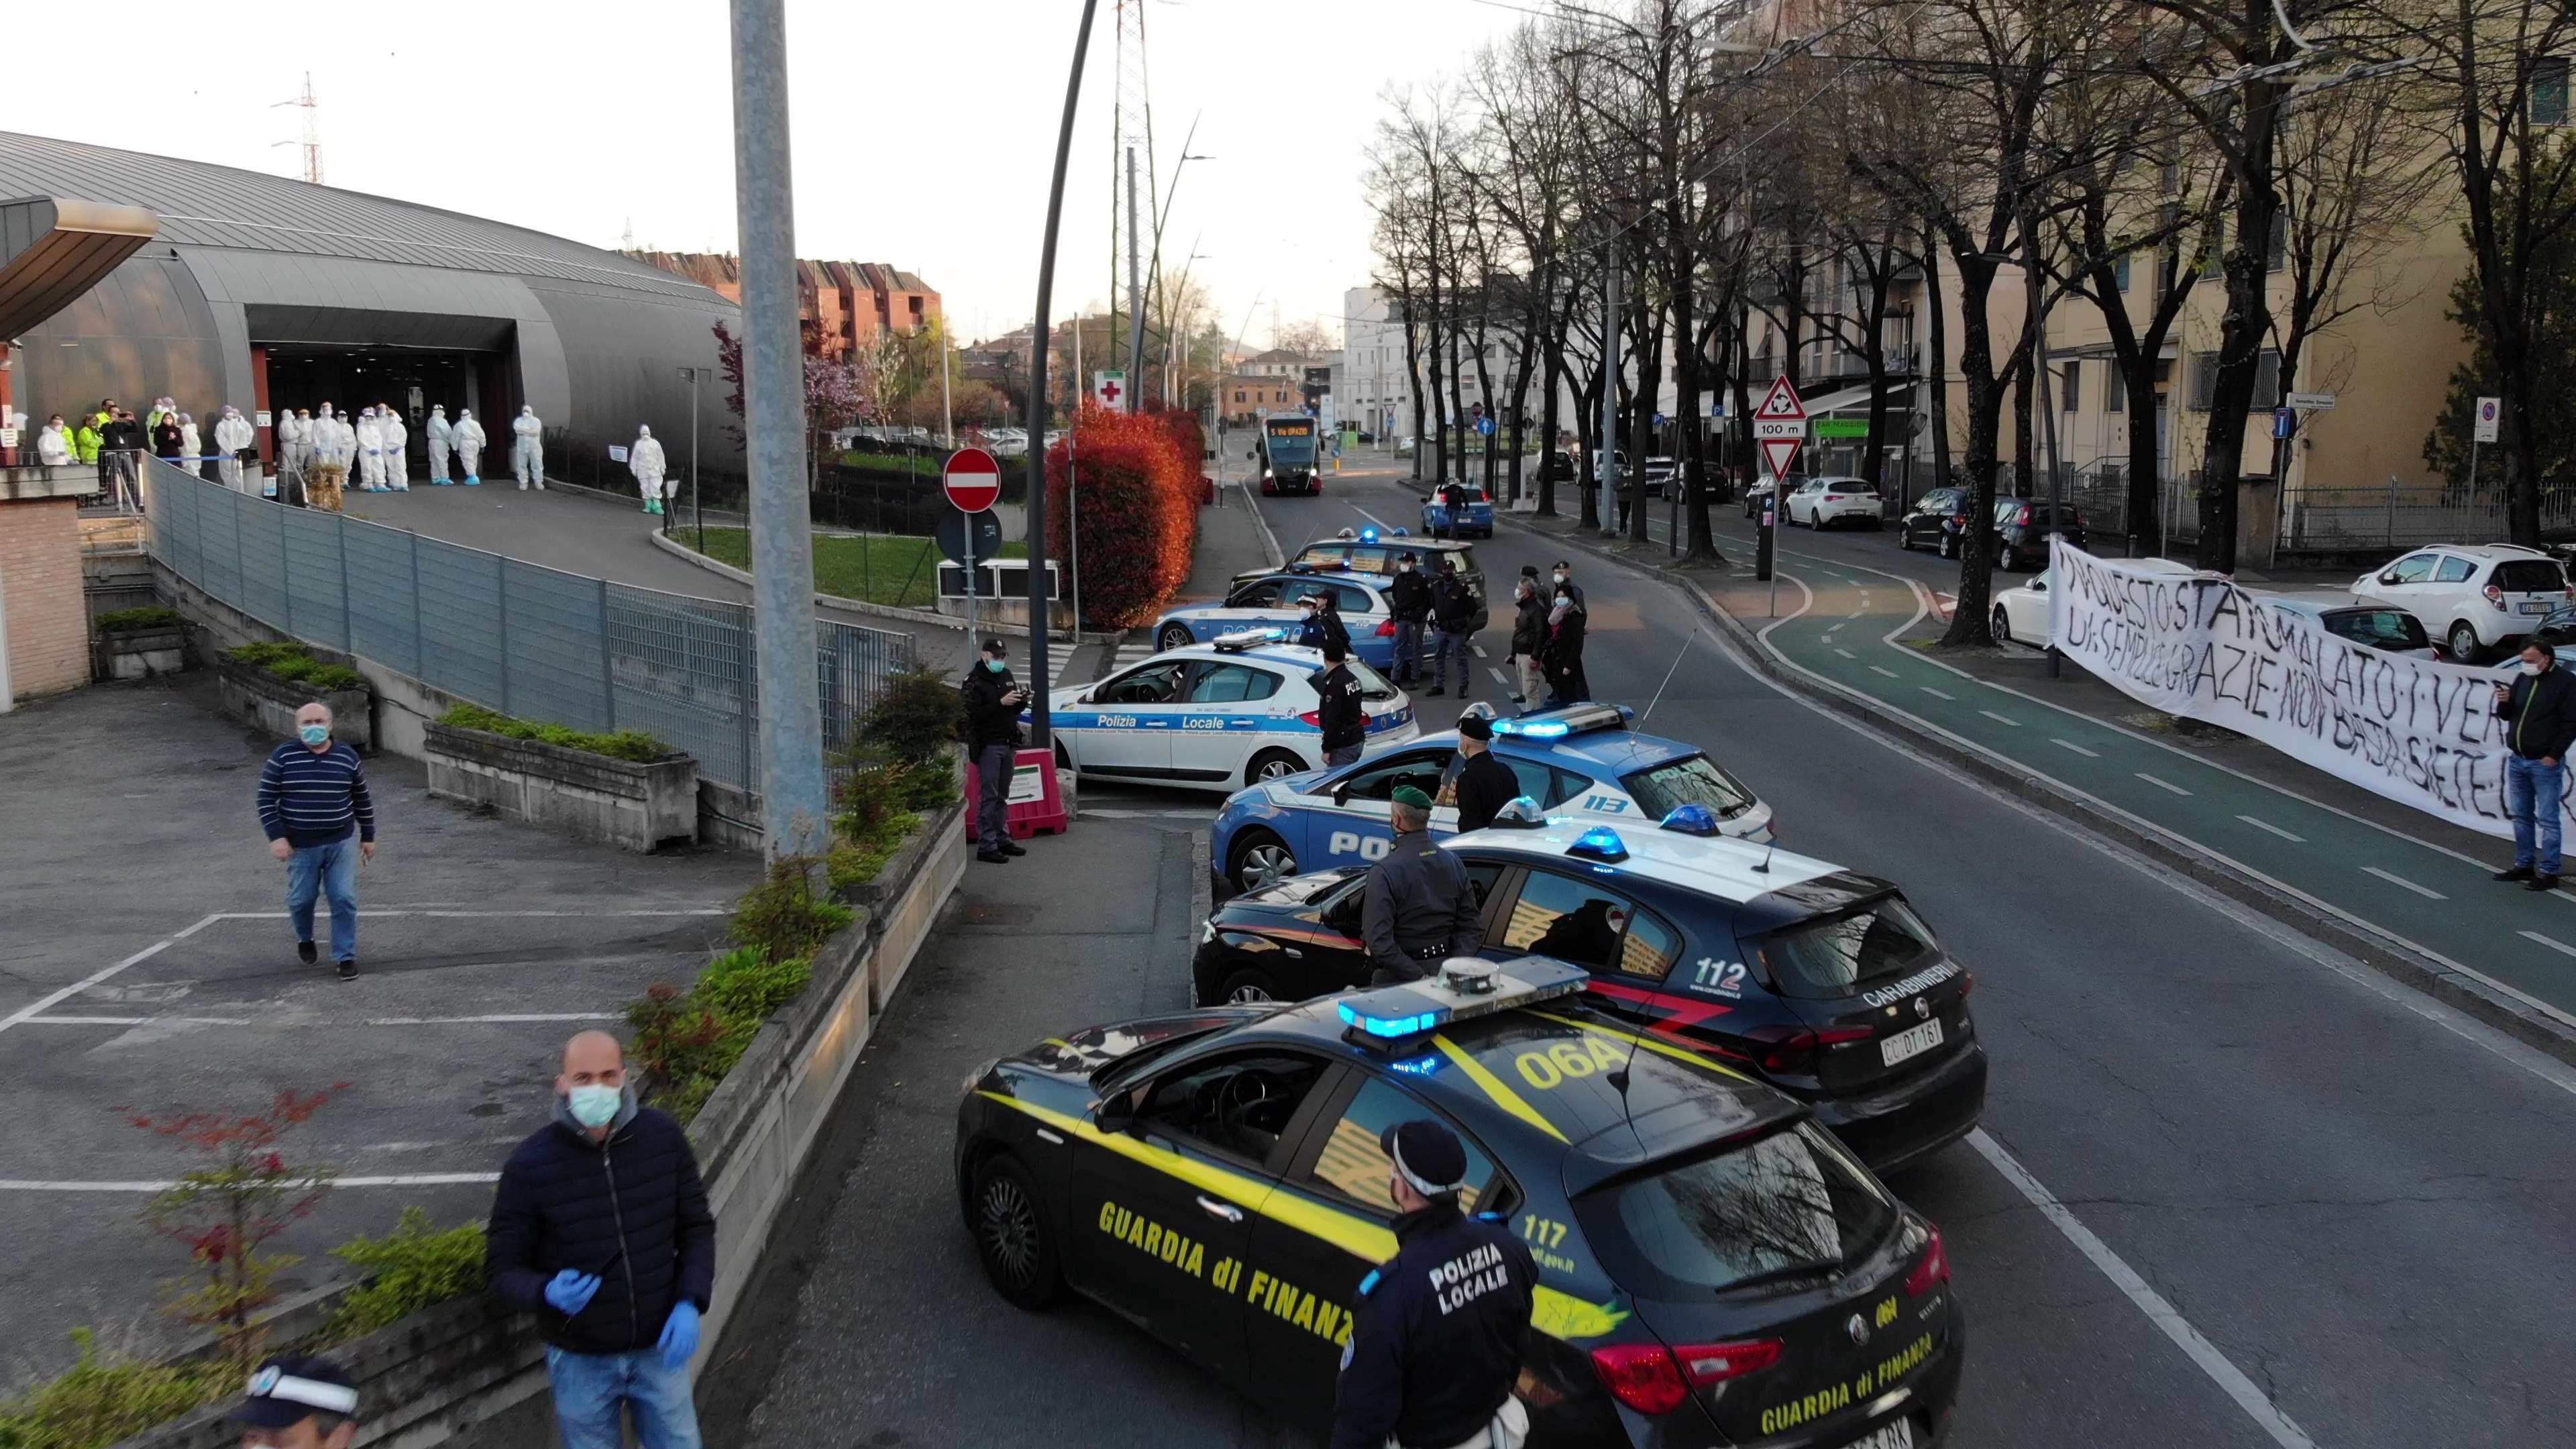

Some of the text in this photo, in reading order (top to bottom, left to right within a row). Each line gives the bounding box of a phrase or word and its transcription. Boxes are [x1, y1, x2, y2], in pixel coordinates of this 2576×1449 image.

[1762, 425, 1782, 434] 100
[1097, 714, 1224, 729] Polizia Locale
[2432, 672, 2514, 746] VER
[1583, 795, 1629, 814] 113
[1695, 957, 1746, 991] 112
[1862, 963, 1954, 1007] CARABINIERI
[1921, 1022, 1939, 1047] 161
[1515, 1036, 1635, 1089] 06A
[1524, 1214, 1568, 1250] 117
[1099, 1201, 1354, 1348] GUARDIA di FINANZ
[1428, 1242, 1503, 1292] POLIZIA
[1438, 1264, 1509, 1316] LOCALE
[1762, 1331, 1933, 1435] GUARDIA di FINANZA
